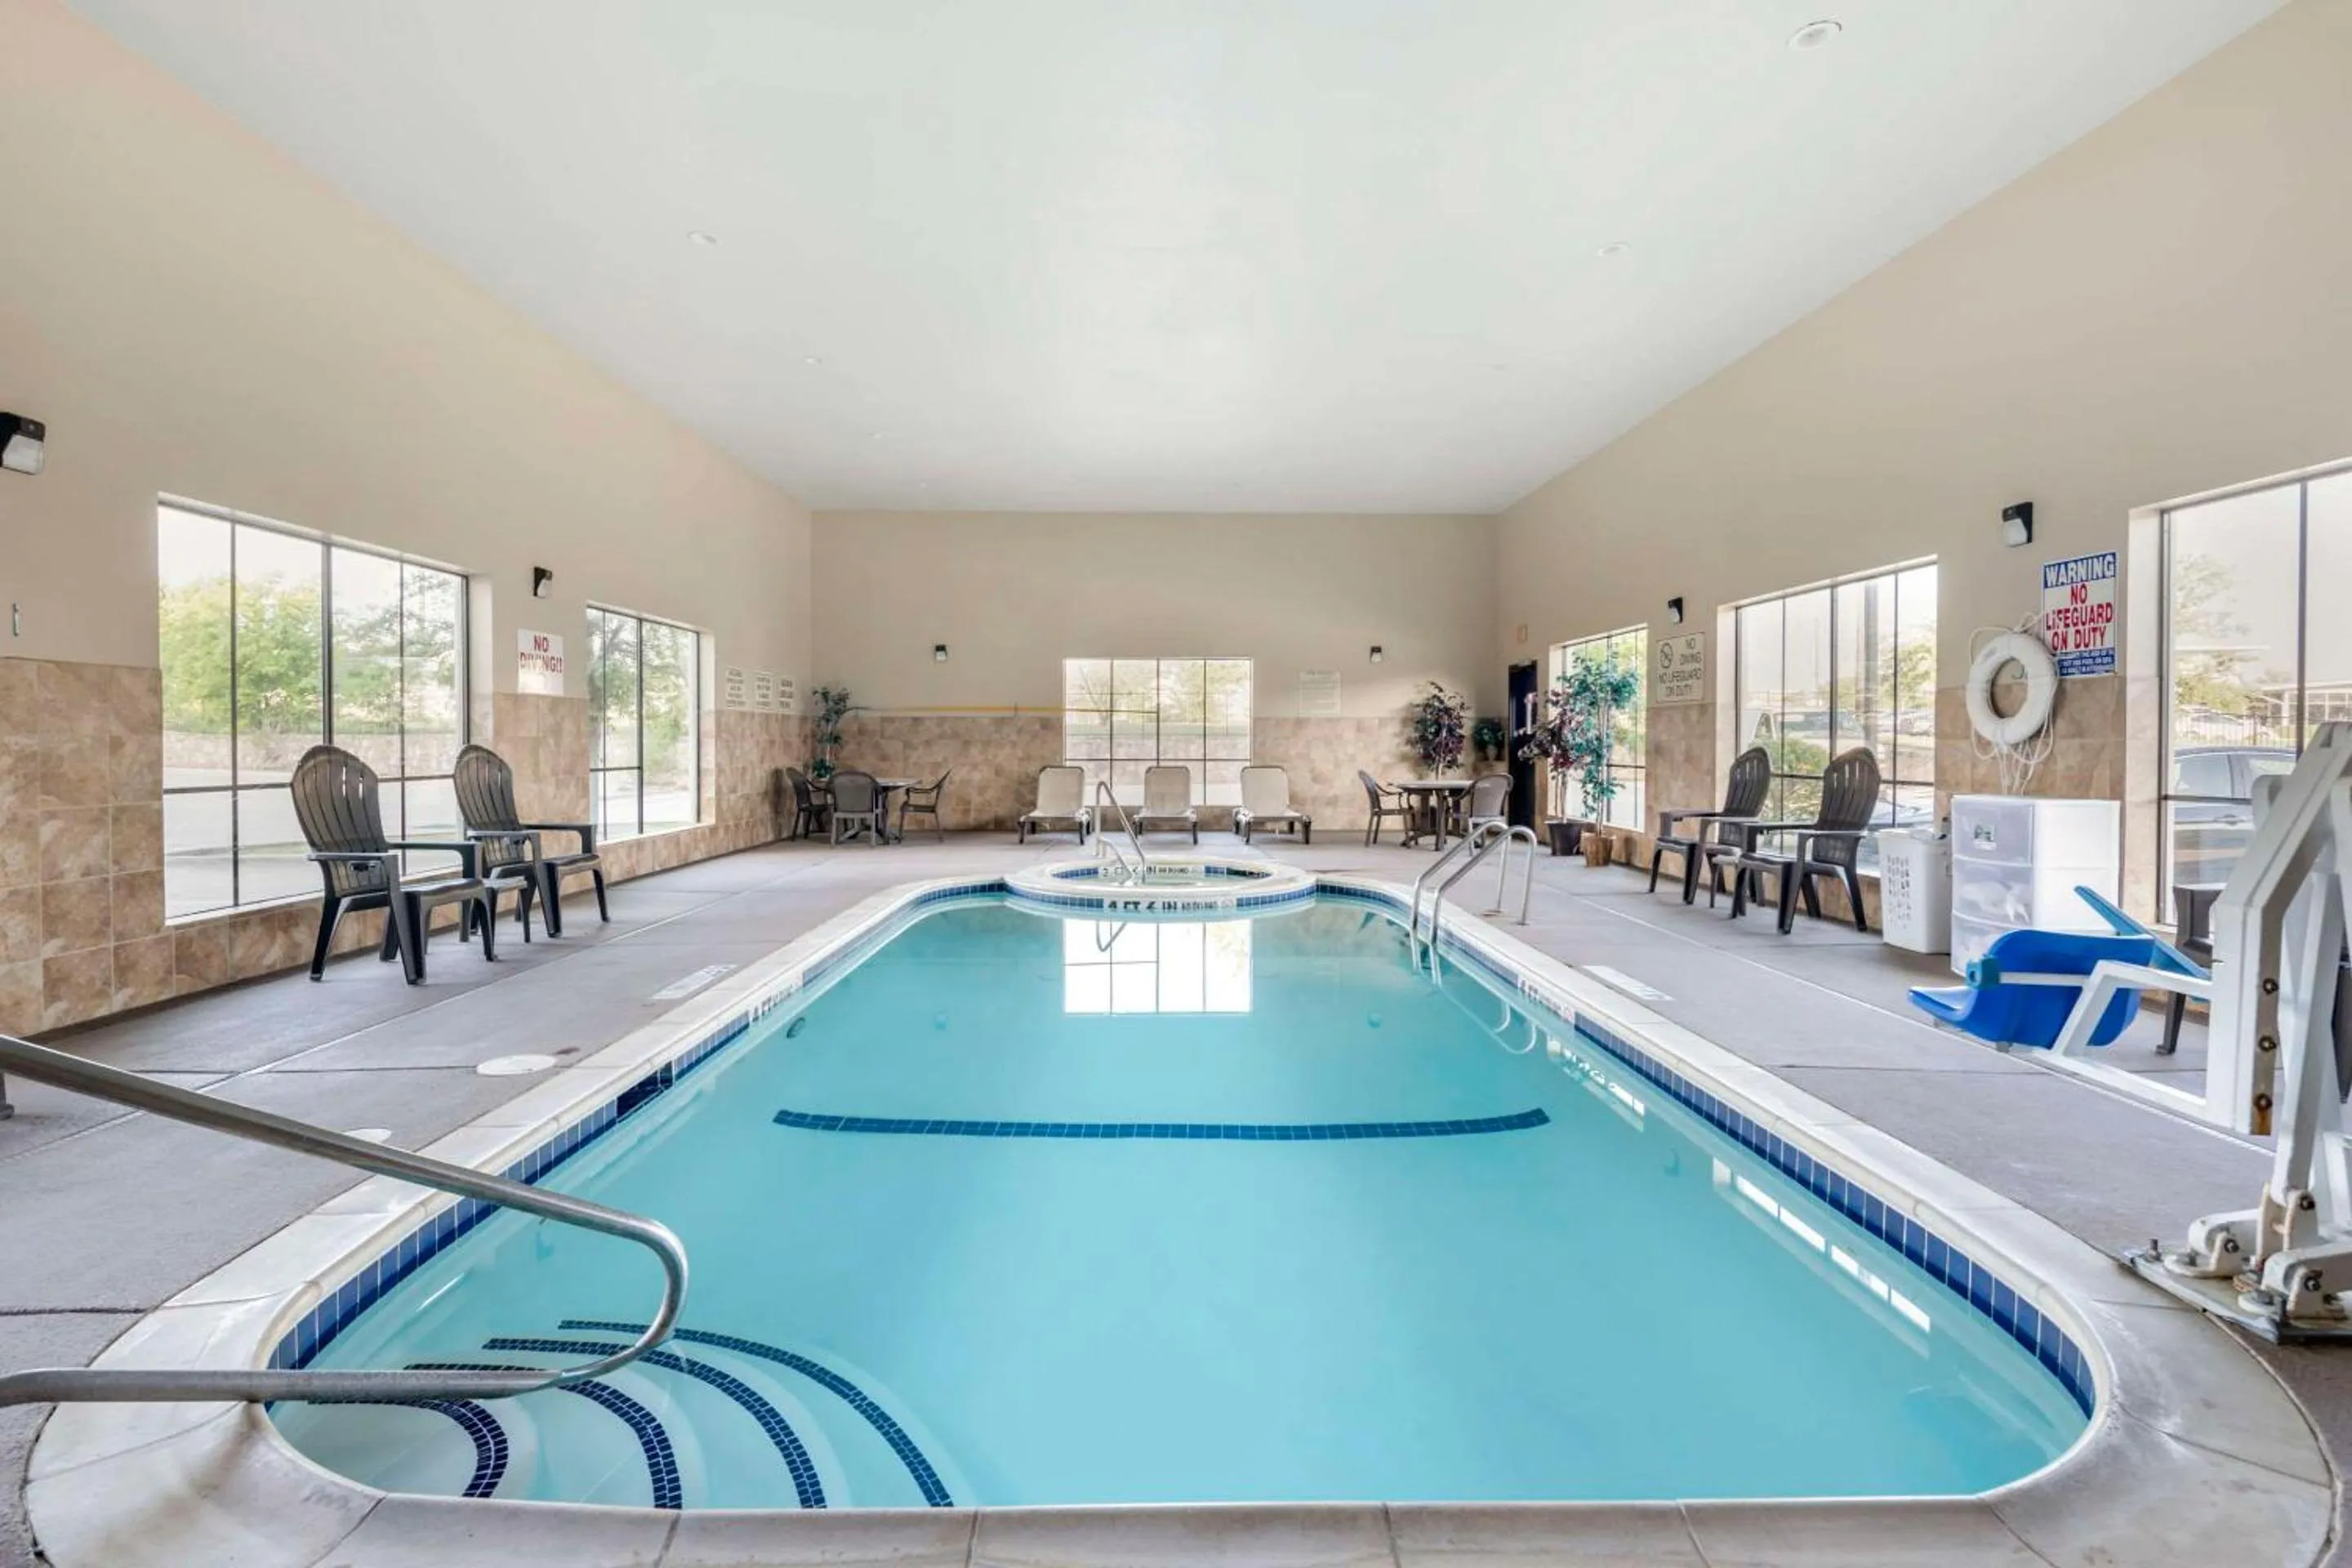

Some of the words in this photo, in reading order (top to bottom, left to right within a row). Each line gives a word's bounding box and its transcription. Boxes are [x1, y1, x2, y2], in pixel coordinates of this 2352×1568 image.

[2045, 555, 2114, 587] WARNING
[2071, 583, 2088, 605] NO
[2046, 603, 2114, 630] LIFEGUARD
[533, 634, 549, 653] NO
[2051, 630, 2069, 652] ON
[2074, 626, 2107, 649] DUTY
